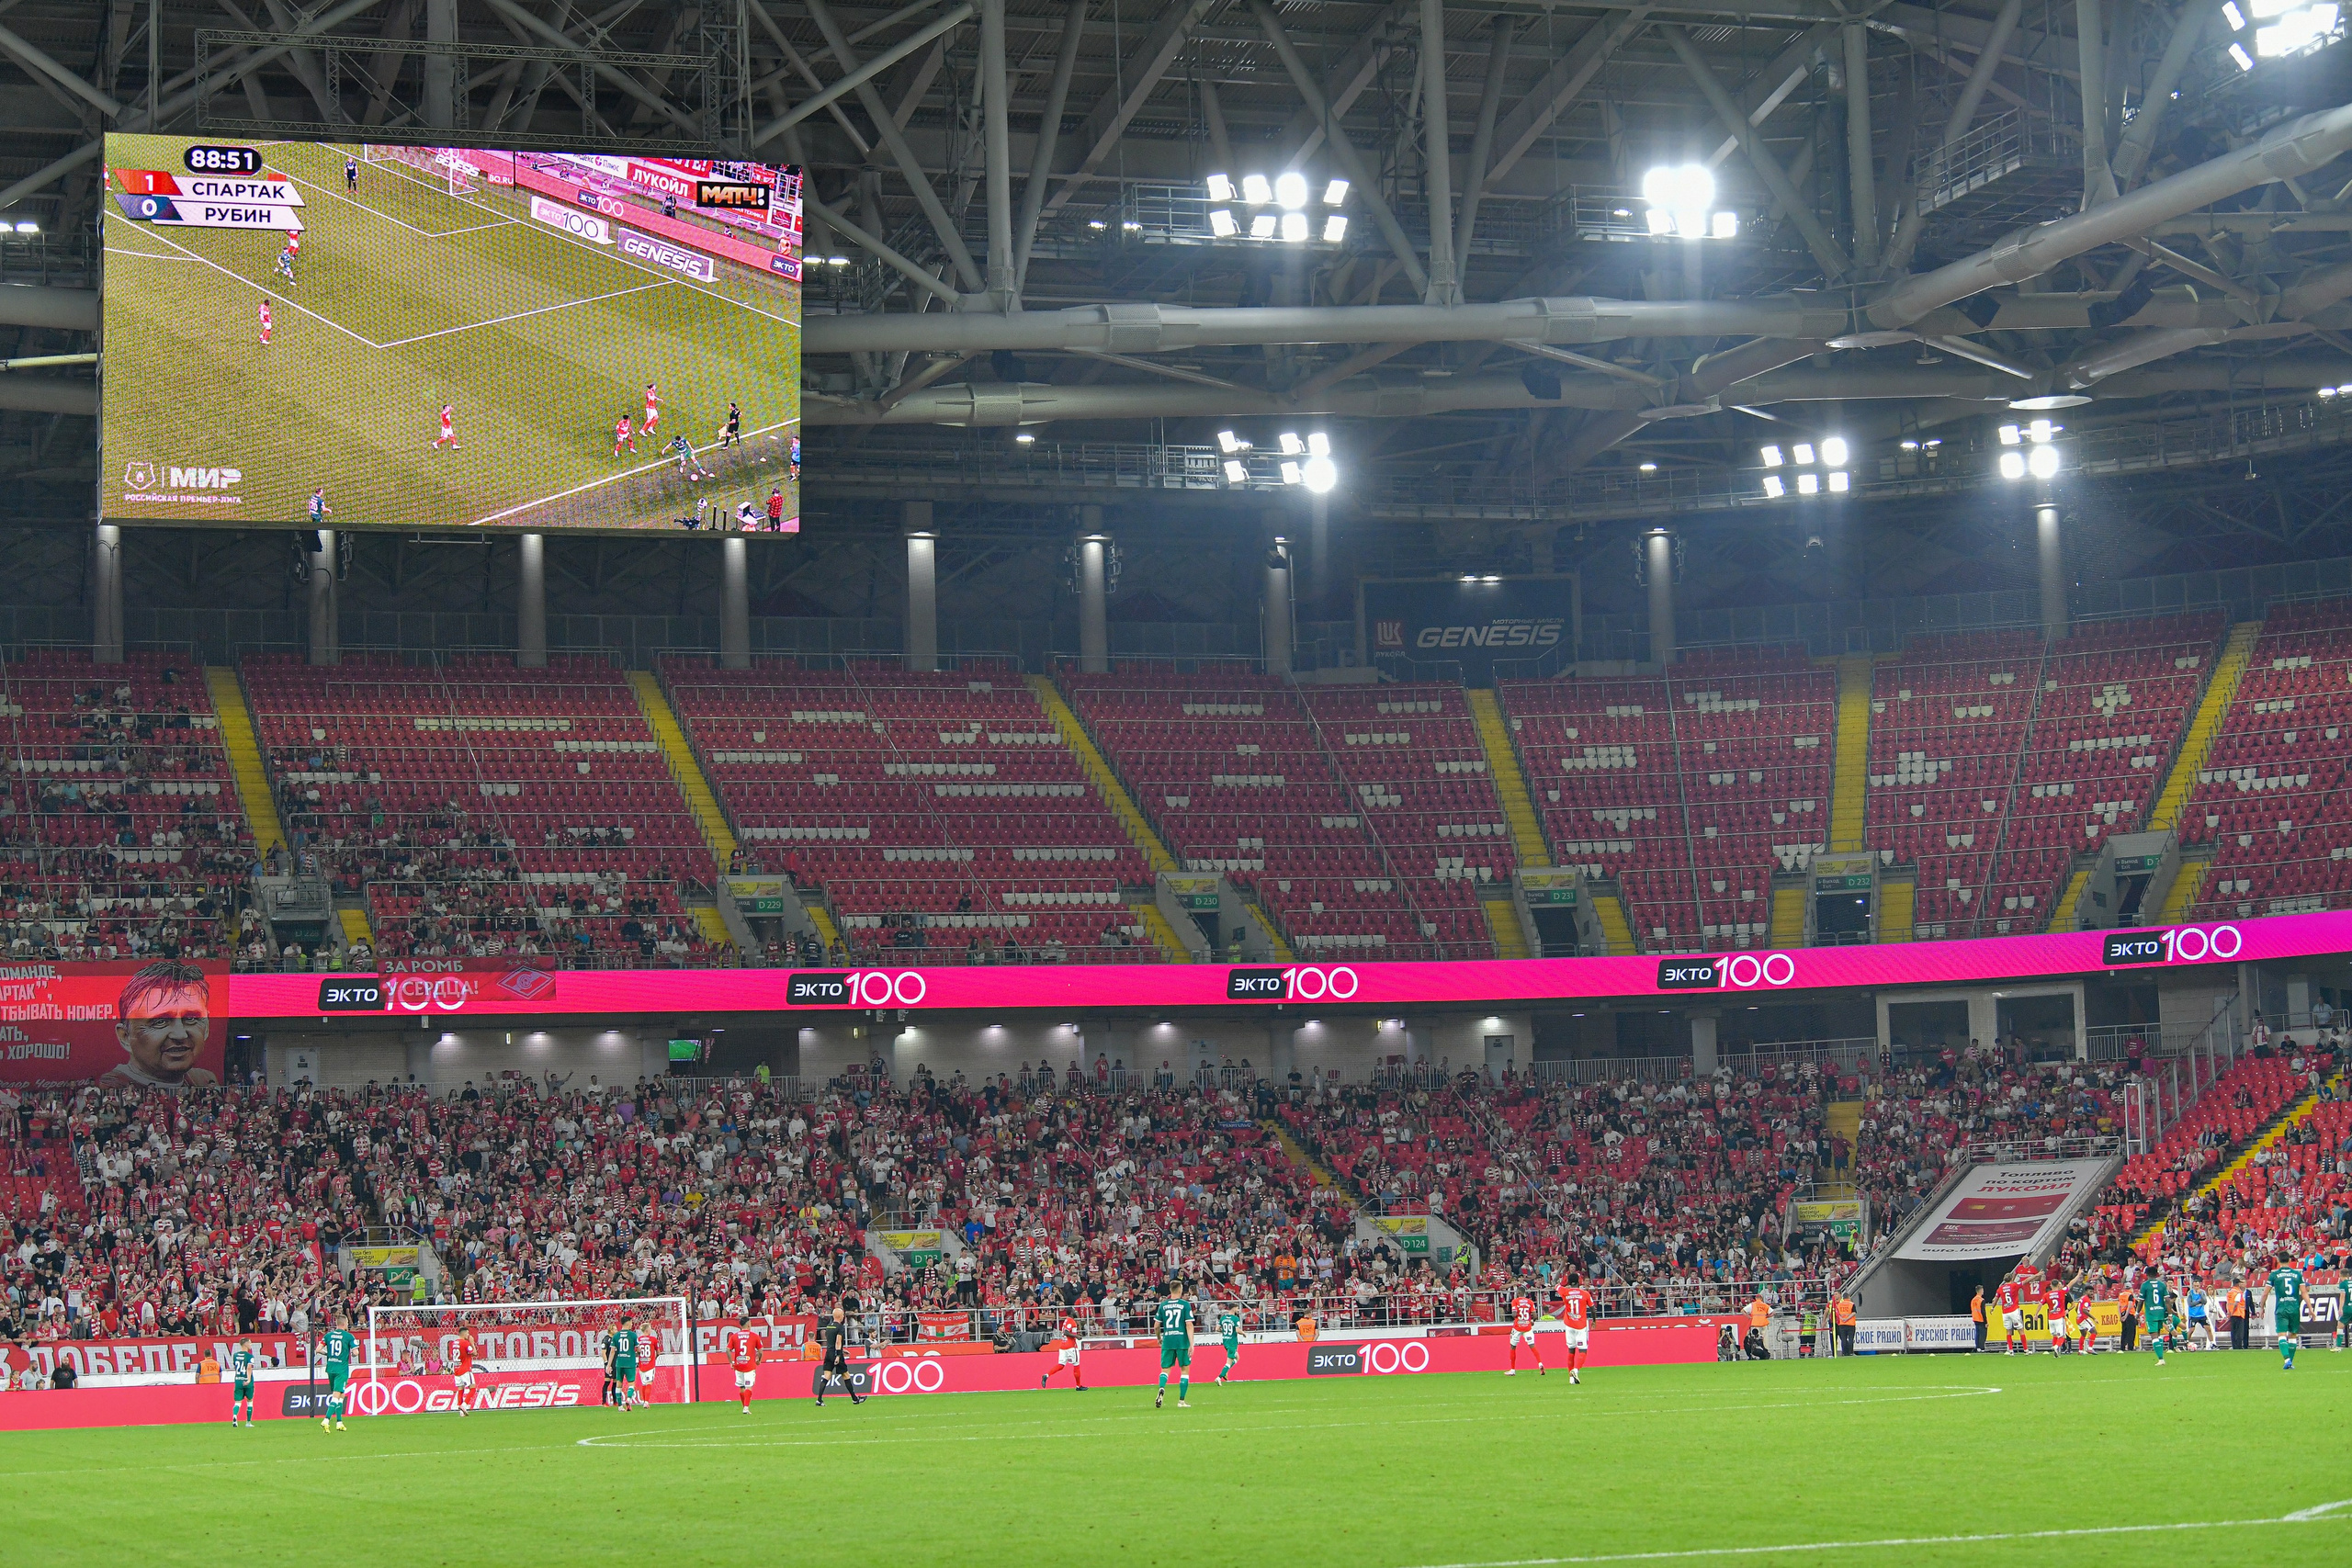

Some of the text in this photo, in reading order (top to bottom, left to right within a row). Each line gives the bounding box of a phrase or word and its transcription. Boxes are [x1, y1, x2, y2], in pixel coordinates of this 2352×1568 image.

[189, 149, 254, 171] 88:51
[145, 175, 285, 199] 1 СПАРТАК
[632, 168, 689, 197] ЛУКОЙЛ
[701, 185, 764, 206] МАТЧ!
[141, 197, 272, 223] 0 РУБИН
[596, 196, 624, 217] 100
[563, 211, 599, 239] 100
[624, 238, 704, 276] GENESIS
[170, 467, 242, 489] МИР
[1416, 624, 1563, 649] GENESIS
[1856, 877, 1871, 886] 232
[767, 900, 782, 909] 229
[1204, 897, 1217, 906] 230
[1561, 892, 1574, 900] 231
[2110, 924, 2243, 962] ЭКТО 100
[385, 959, 464, 974] ЗА РОМБ
[1664, 953, 1795, 987] ЭКТО 100
[385, 979, 480, 999] У СЕРДЦА!
[794, 971, 926, 1005] ЭКТО 100
[1234, 966, 1359, 999] ЭКТО 100
[326, 987, 378, 1002] ЭКТО
[67, 1004, 118, 1021] НОМЕР.
[7, 1042, 72, 1060] ХОРОШО!
[1999, 1169, 2075, 1178] Топливо
[2011, 1176, 2076, 1185] картам
[1976, 1182, 2073, 1192] ЛУКОЙЛ
[1835, 1224, 1842, 1234] D
[1922, 1244, 2019, 1253] auto.lukoil.ru
[914, 1255, 922, 1264] D
[2030, 1283, 2040, 1295] 12
[2284, 1278, 2293, 1295] 5
[2005, 1292, 2012, 1303] 6
[2052, 1299, 2059, 1309] 2
[2153, 1289, 2160, 1304] 6
[1518, 1307, 1530, 1320] 35
[1568, 1299, 1579, 1314] 11
[1165, 1309, 1182, 1329] 27
[1222, 1322, 1234, 1336] 99
[1876, 1330, 1902, 1344] РАДИО
[1915, 1327, 1975, 1342] РУССКОЕ РАДИО
[617, 1337, 629, 1352] 10
[635, 1323, 806, 1354] МЕСТЕ!
[329, 1339, 343, 1357] 19
[639, 1344, 651, 1358] 68
[739, 1339, 748, 1356] 5
[1314, 1341, 1430, 1374] ЭКТО 100
[234, 1360, 246, 1375] 24
[820, 1359, 944, 1393] ЭКО 100
[343, 1379, 424, 1416] 100
